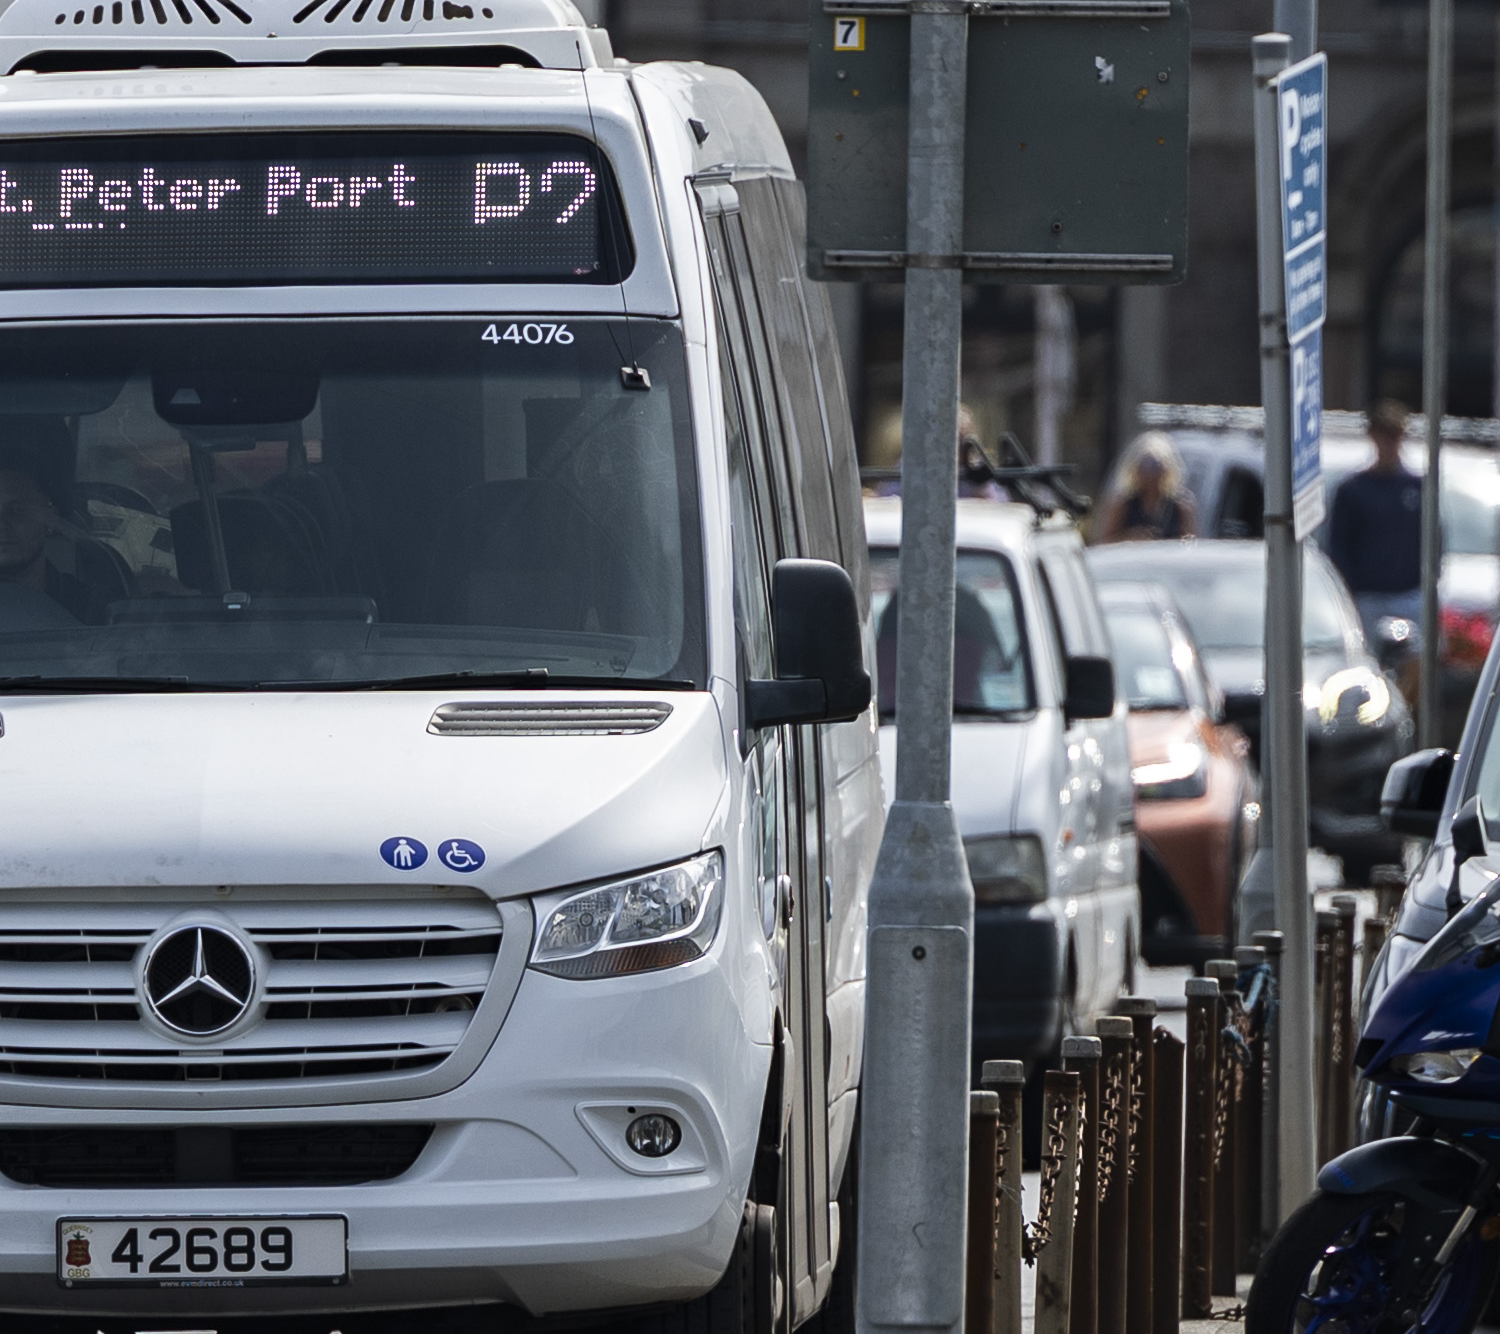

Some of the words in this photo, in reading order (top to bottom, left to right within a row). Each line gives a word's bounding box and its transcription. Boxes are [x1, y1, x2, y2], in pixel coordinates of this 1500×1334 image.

[839, 20, 857, 44] 7
[59, 167, 241, 217] Peter
[266, 163, 416, 215] Port
[481, 323, 575, 345] 44076
[110, 1226, 293, 1274] 42689
[67, 1268, 91, 1278] GBG
